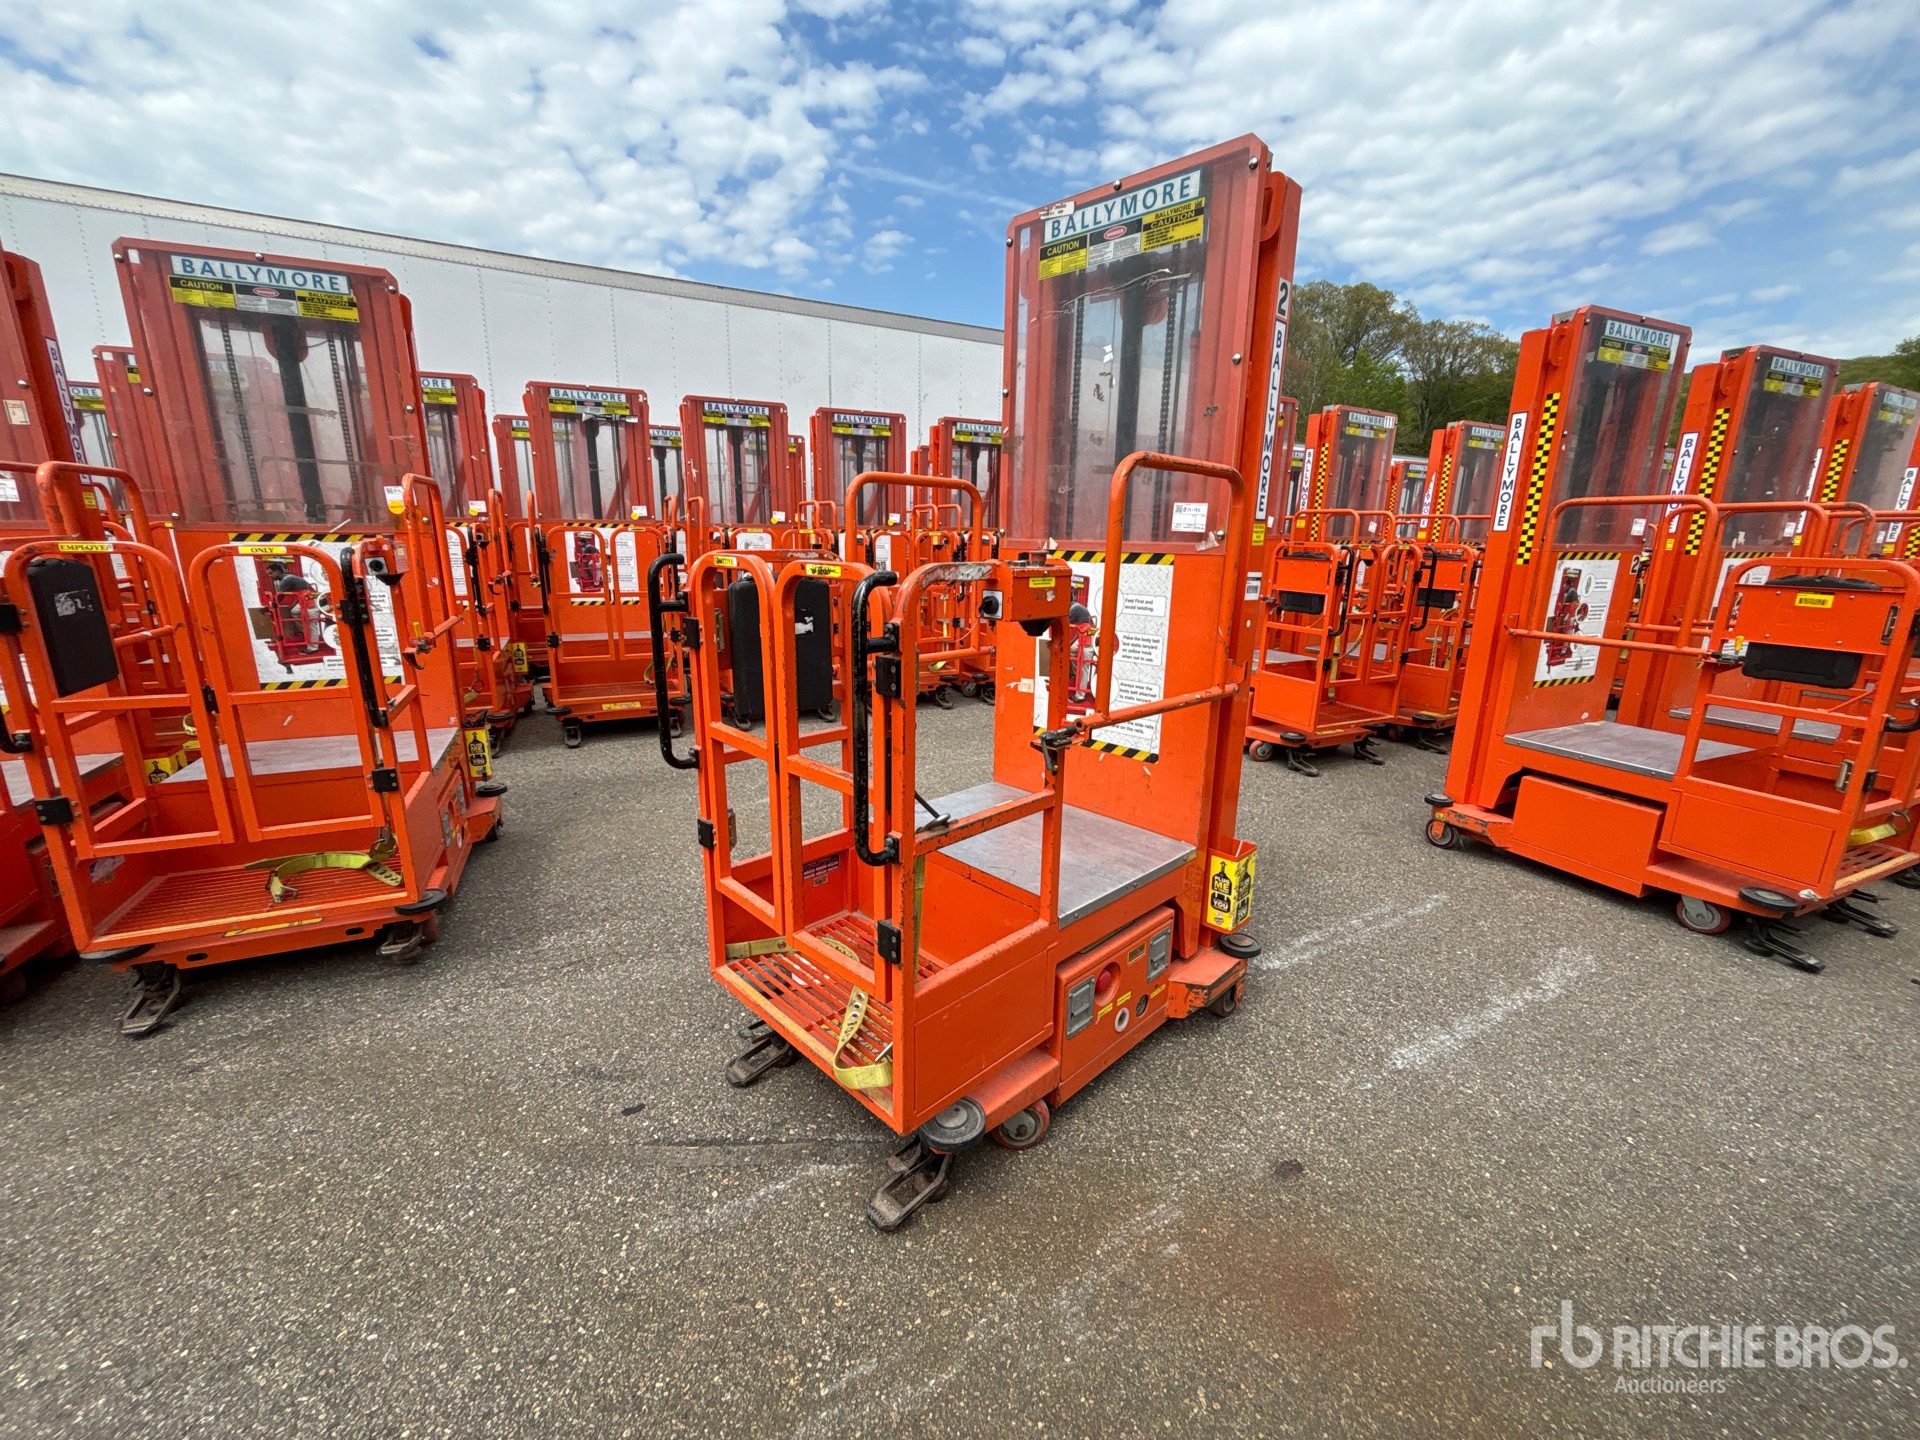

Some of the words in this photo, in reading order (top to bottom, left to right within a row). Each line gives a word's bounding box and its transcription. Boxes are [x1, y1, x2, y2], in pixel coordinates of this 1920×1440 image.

[1051, 175, 1191, 239] BALLYMORE
[1154, 203, 1191, 220] BALLYMORE
[1150, 211, 1195, 229] CAUTION
[1046, 240, 1080, 257] CAUTION
[181, 258, 341, 291] BALLYMORE
[179, 279, 223, 291] CAUTION
[305, 297, 349, 307] CAUTION
[1277, 282, 1288, 317] 2
[1608, 322, 1670, 346] BALLYMORE
[1773, 358, 1823, 378] BALLYMORE
[554, 389, 622, 402] BALLYMORE
[707, 403, 766, 415] BALLYMORE
[837, 415, 888, 425] BALLYMORE
[1258, 330, 1282, 513] BALLYMORE
[1350, 413, 1385, 425] BALLYMORE
[1497, 418, 1523, 527] BALLYMORE
[1214, 875, 1230, 884] PLUG
[1214, 880, 1230, 890] ME
[1213, 900, 1229, 910] YOU
